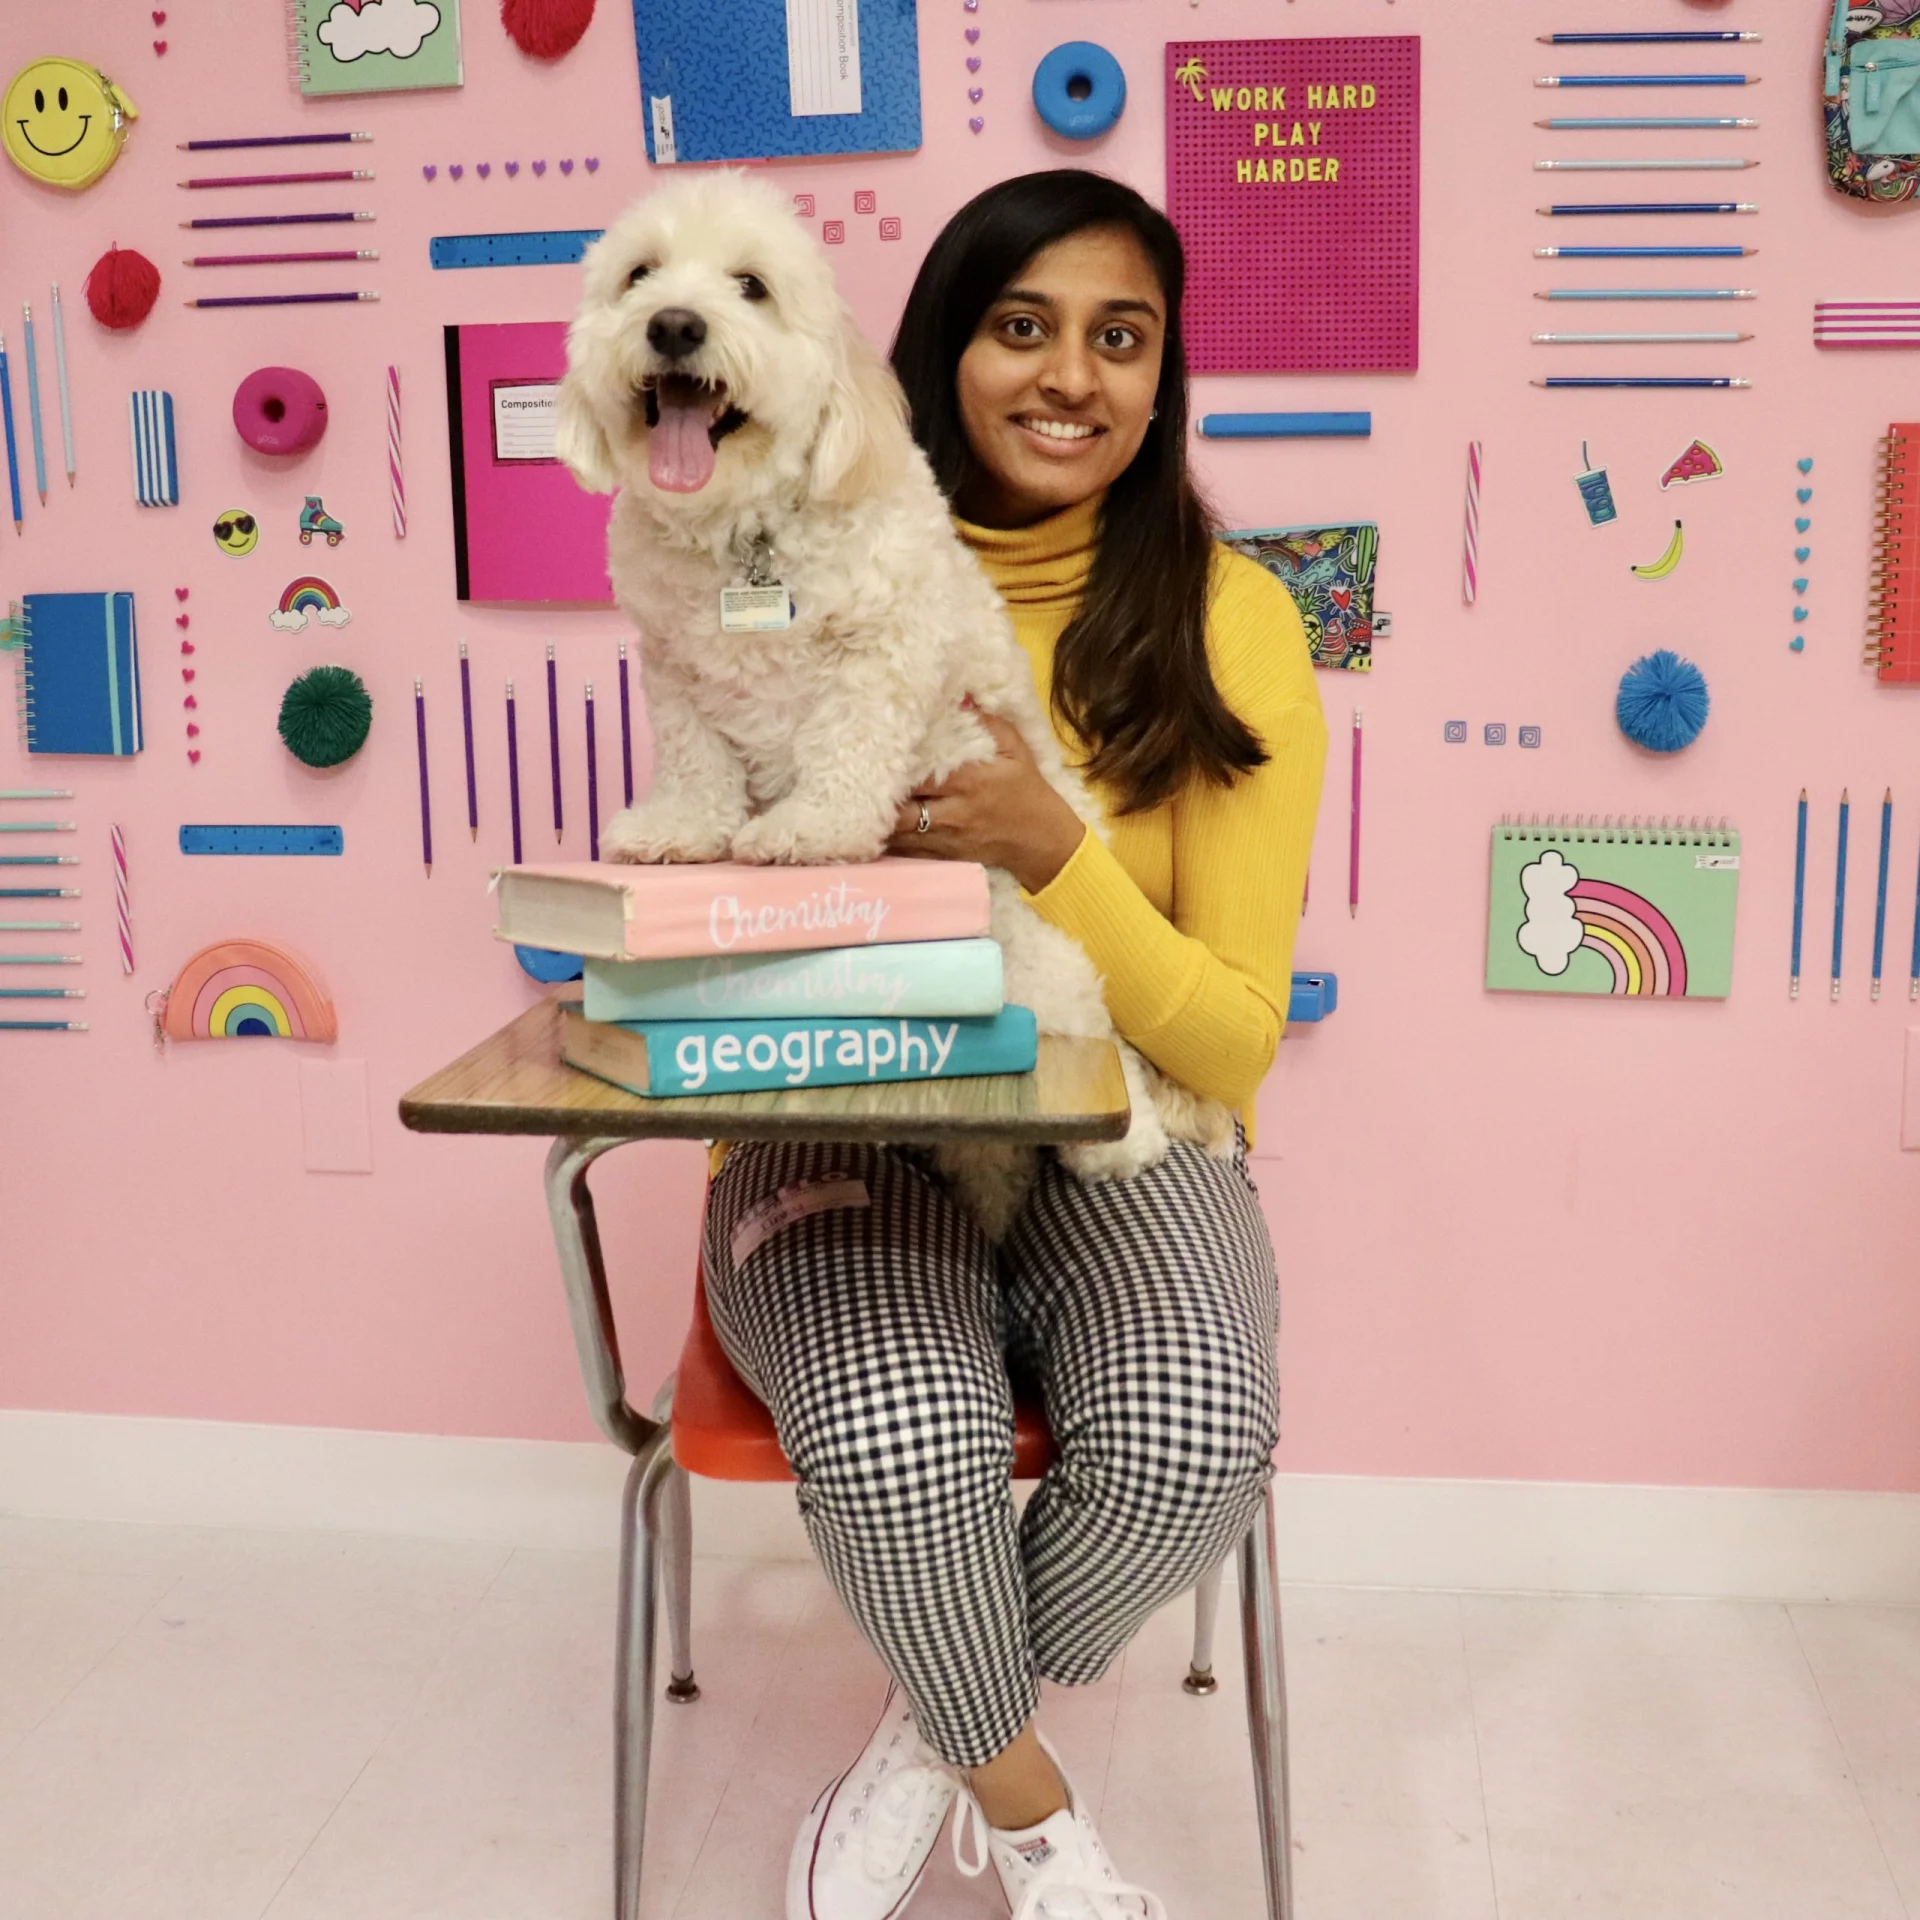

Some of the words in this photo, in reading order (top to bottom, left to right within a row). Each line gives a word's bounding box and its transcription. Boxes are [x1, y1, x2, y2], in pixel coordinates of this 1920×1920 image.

[835, 0, 847, 53] omposition
[839, 55, 849, 80] Book
[1210, 87, 1286, 112] WORK
[1307, 84, 1377, 110] HARD
[1254, 121, 1322, 147] PLAY
[1236, 157, 1340, 183] HARDER
[709, 880, 891, 948] Chemistry
[697, 955, 911, 1010] Chemistry
[675, 1020, 959, 1090] geography
